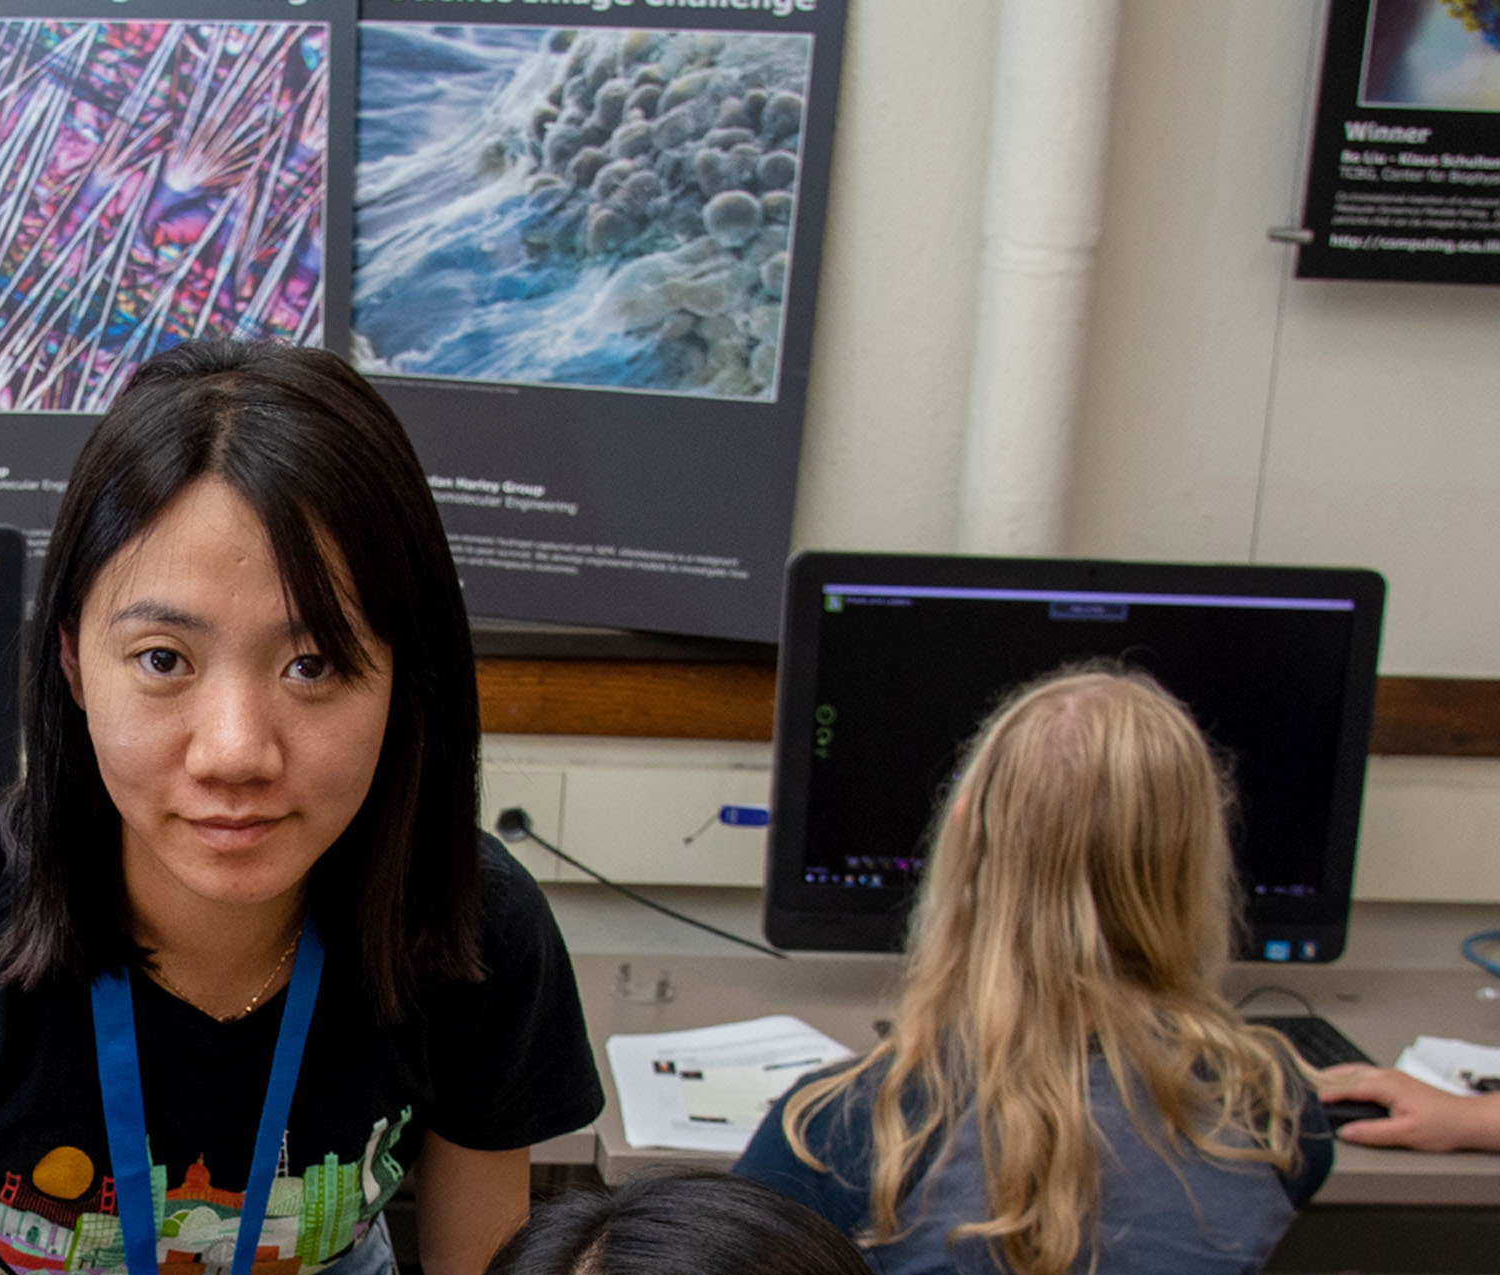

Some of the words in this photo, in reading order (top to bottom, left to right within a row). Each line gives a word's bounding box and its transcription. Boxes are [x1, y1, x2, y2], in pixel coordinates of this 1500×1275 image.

[1344, 120, 1433, 144] Winner
[502, 480, 546, 498] Group
[504, 495, 579, 517] Engineering
